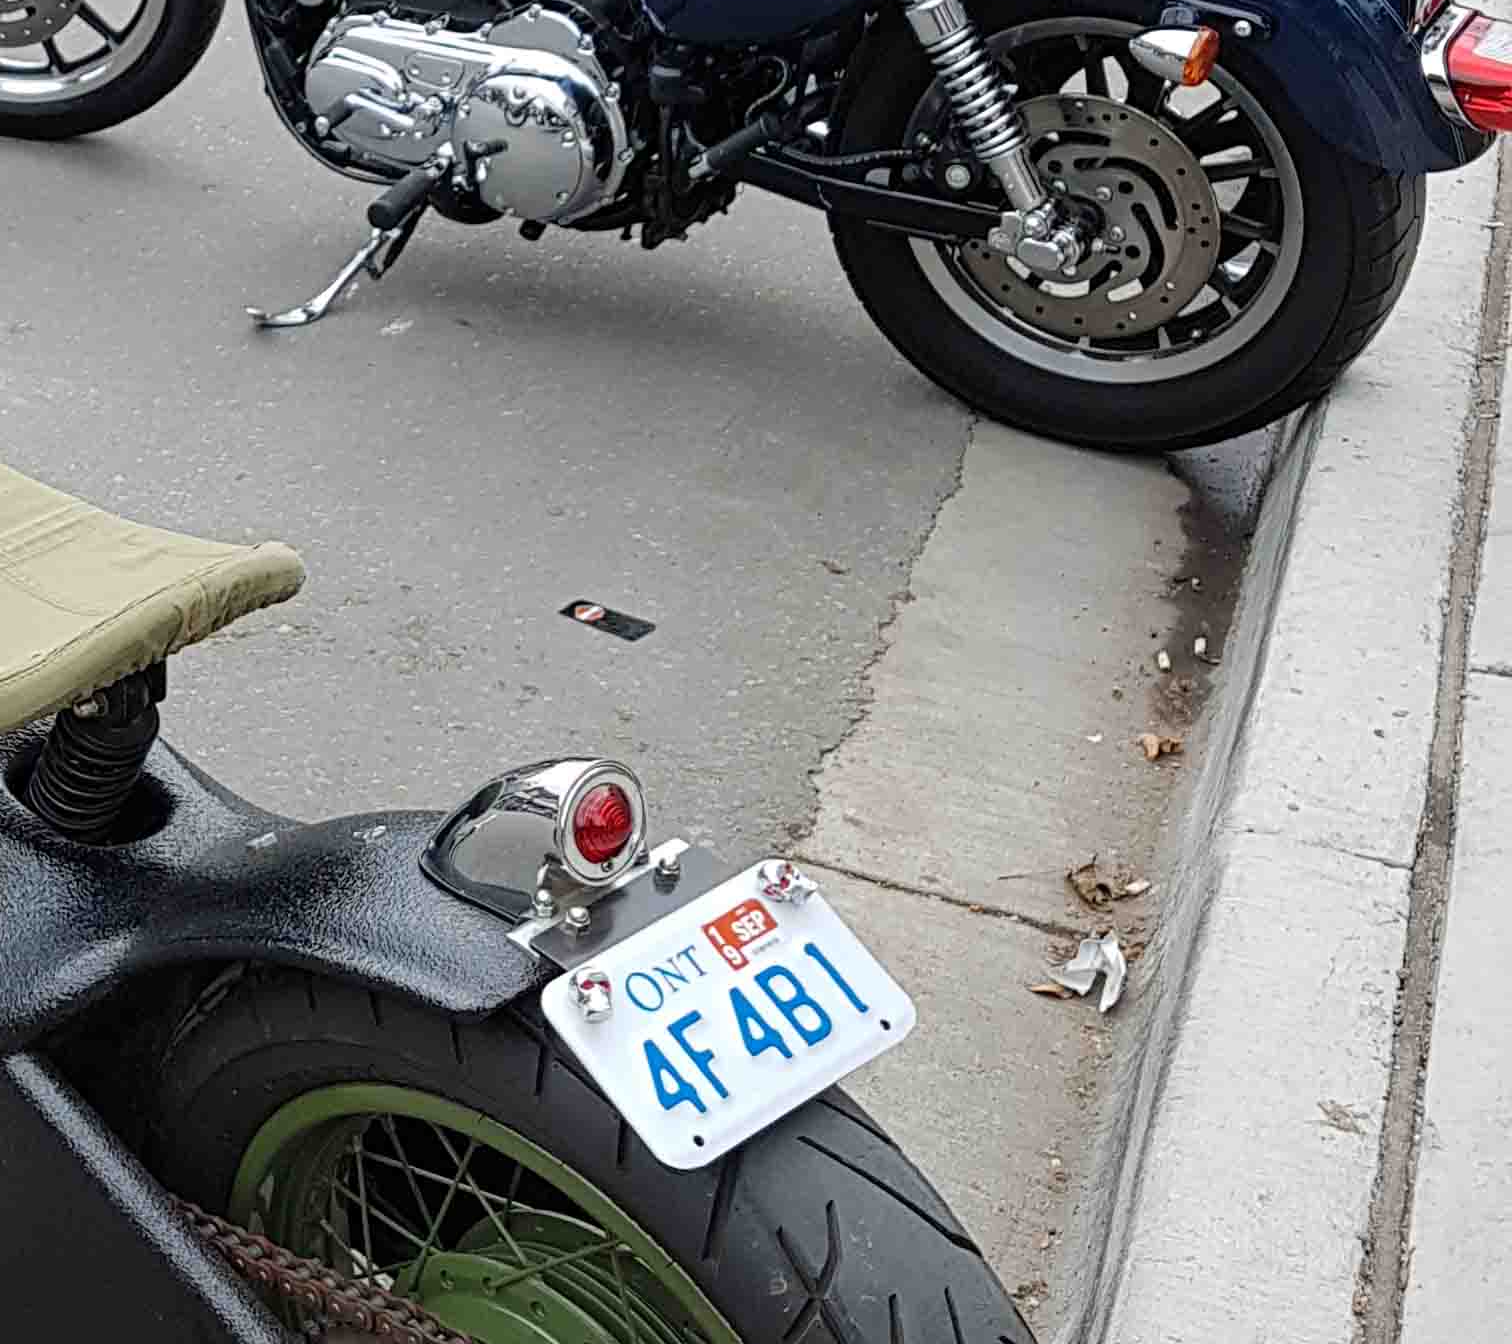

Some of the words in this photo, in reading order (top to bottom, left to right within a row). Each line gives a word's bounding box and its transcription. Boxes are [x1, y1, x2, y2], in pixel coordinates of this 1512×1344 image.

[730, 909, 767, 942] SEP
[625, 946, 708, 1012] ONT
[643, 1010, 729, 1113] 4F
